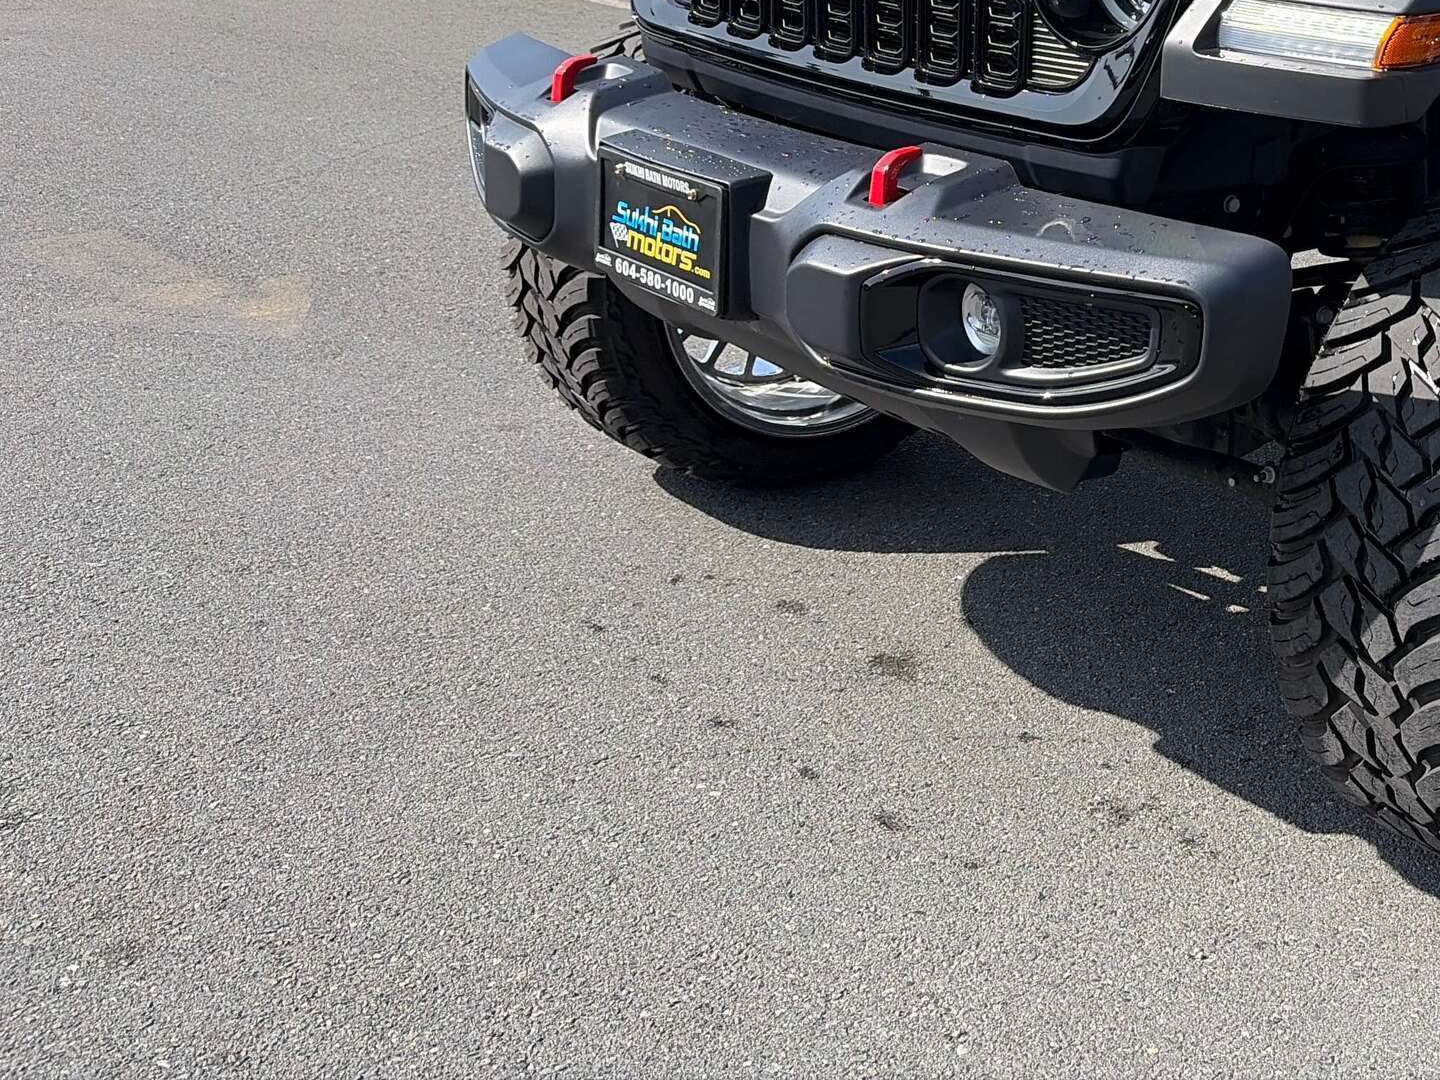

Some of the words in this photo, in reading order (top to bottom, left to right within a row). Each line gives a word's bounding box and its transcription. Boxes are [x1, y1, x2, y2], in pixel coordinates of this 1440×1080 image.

[624, 161, 645, 180] SUKHI
[645, 168, 662, 186] BATH
[661, 174, 690, 195] MOTORS
[612, 201, 659, 237] Sukhi
[661, 217, 700, 252] Bath
[615, 257, 695, 304] 604-580-1000
